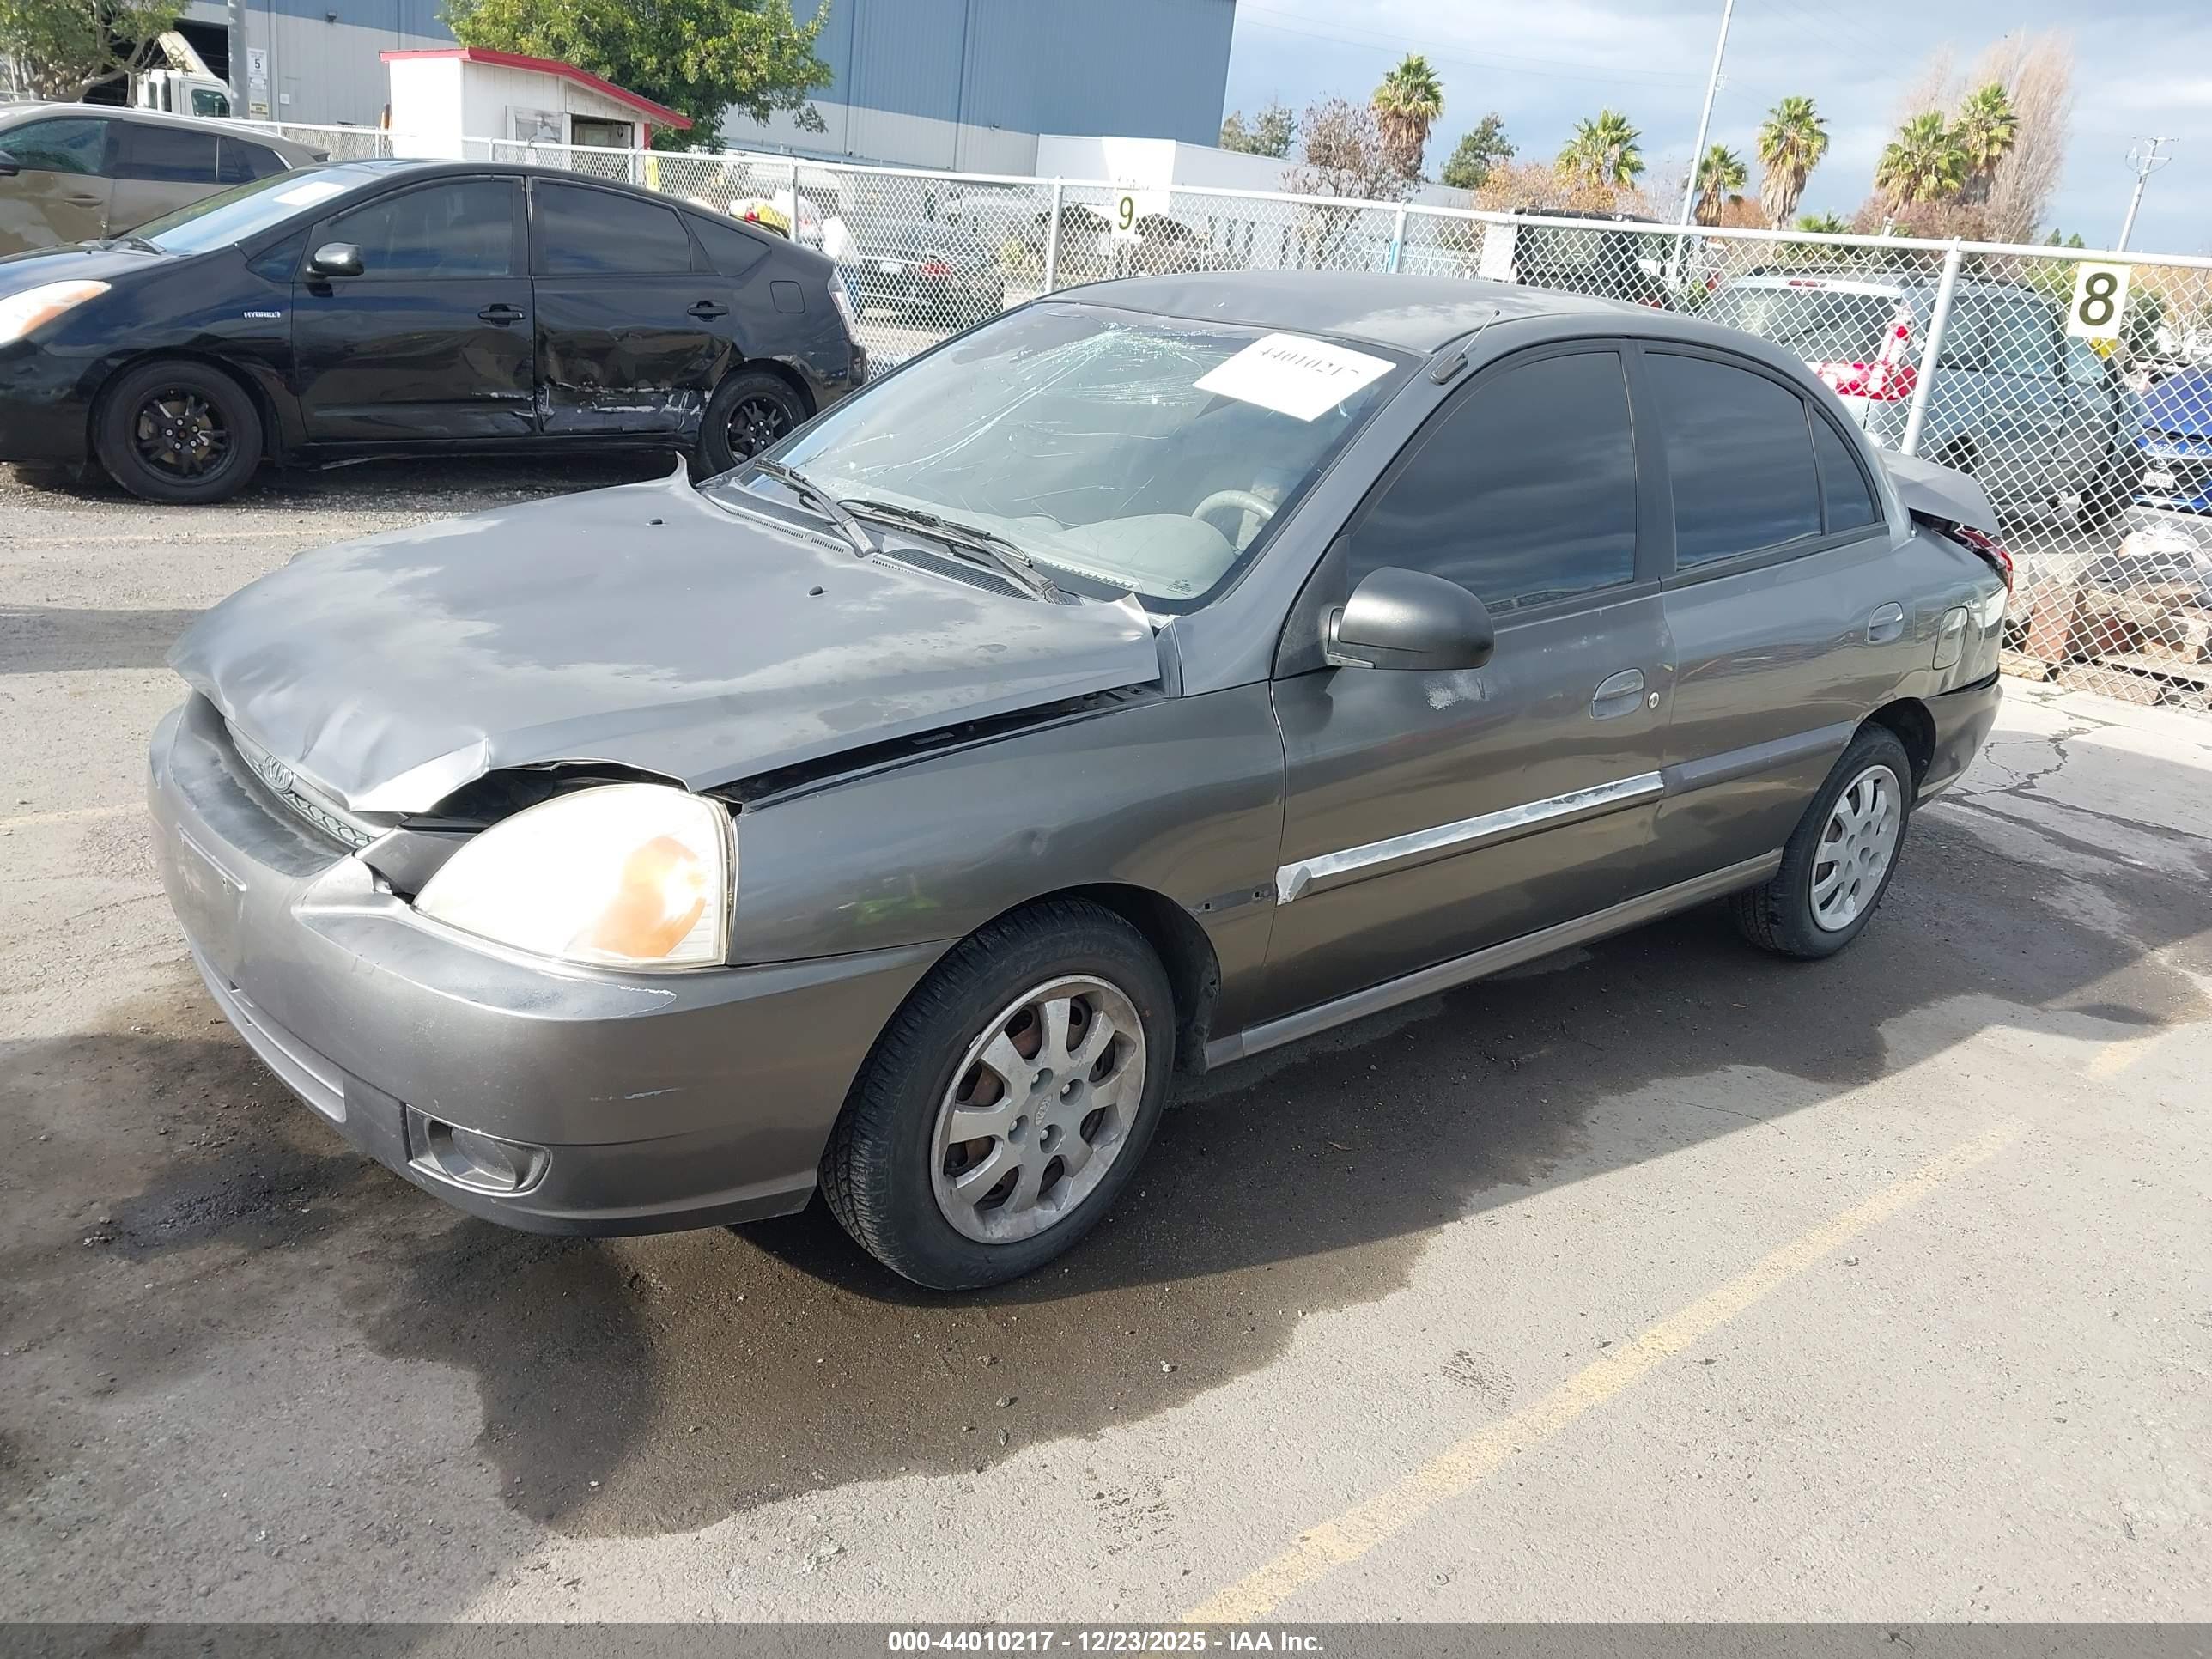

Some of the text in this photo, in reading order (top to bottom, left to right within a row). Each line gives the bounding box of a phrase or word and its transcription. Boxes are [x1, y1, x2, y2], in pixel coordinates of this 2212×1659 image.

[254, 58, 261, 69] 5
[1119, 197, 1133, 230] 9
[2079, 272, 2118, 326] 8
